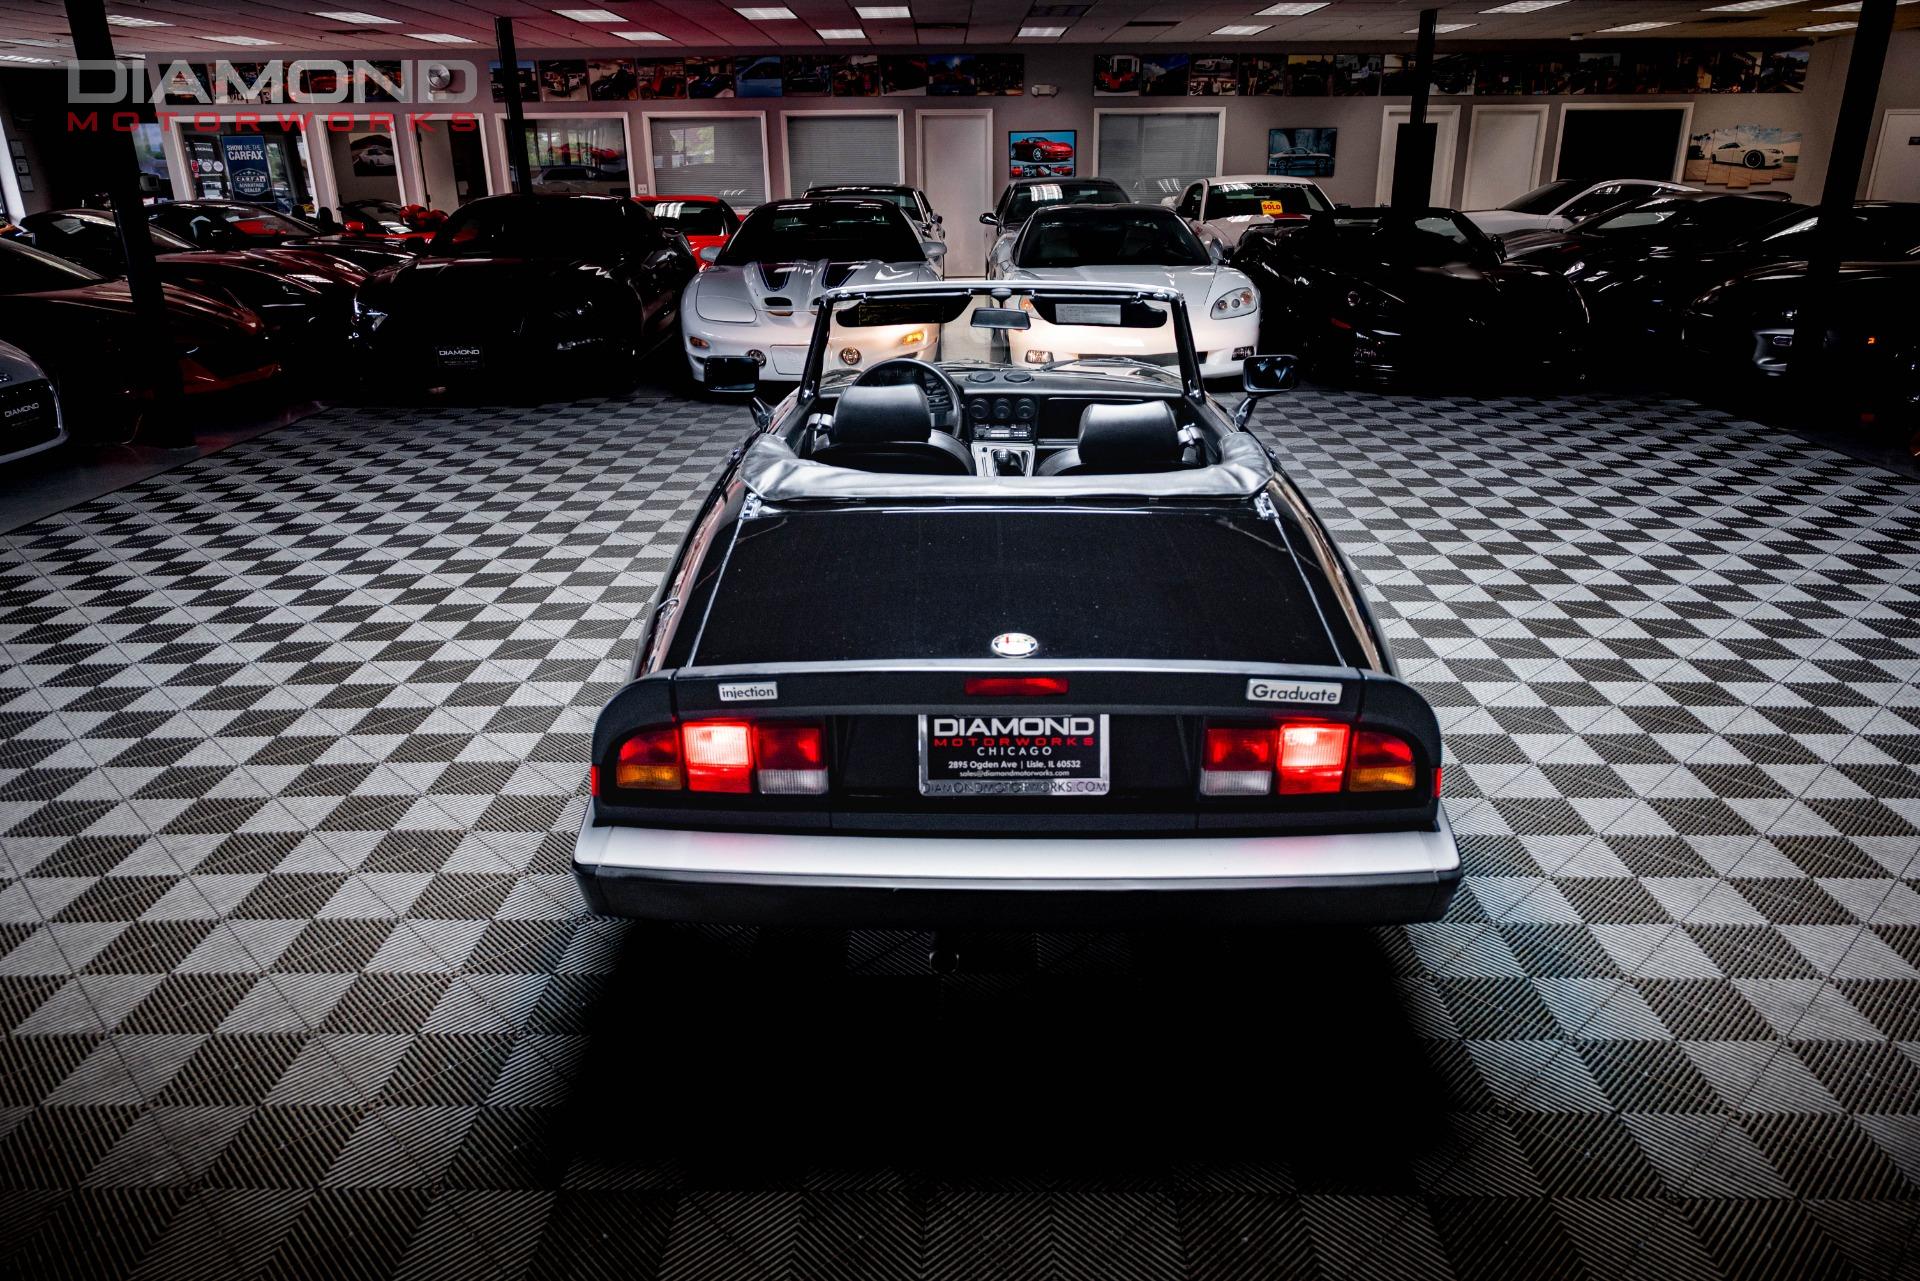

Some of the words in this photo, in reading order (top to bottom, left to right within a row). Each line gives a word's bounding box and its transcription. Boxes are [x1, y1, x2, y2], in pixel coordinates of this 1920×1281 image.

[228, 151, 263, 160] CARFAX
[4, 402, 40, 418] DIAMOND
[722, 686, 774, 698] injection
[1252, 684, 1338, 702] Graduate
[933, 717, 1095, 737] DIAMOND
[933, 737, 1094, 747] MOTORWORKS
[976, 746, 1052, 756] CHICAGO
[948, 760, 968, 769] 2895
[969, 760, 999, 770] Ogden
[1000, 760, 1018, 768] Ave
[1026, 760, 1047, 769] Lisle,
[1048, 760, 1056, 768] IL
[1056, 760, 1081, 768] 60532
